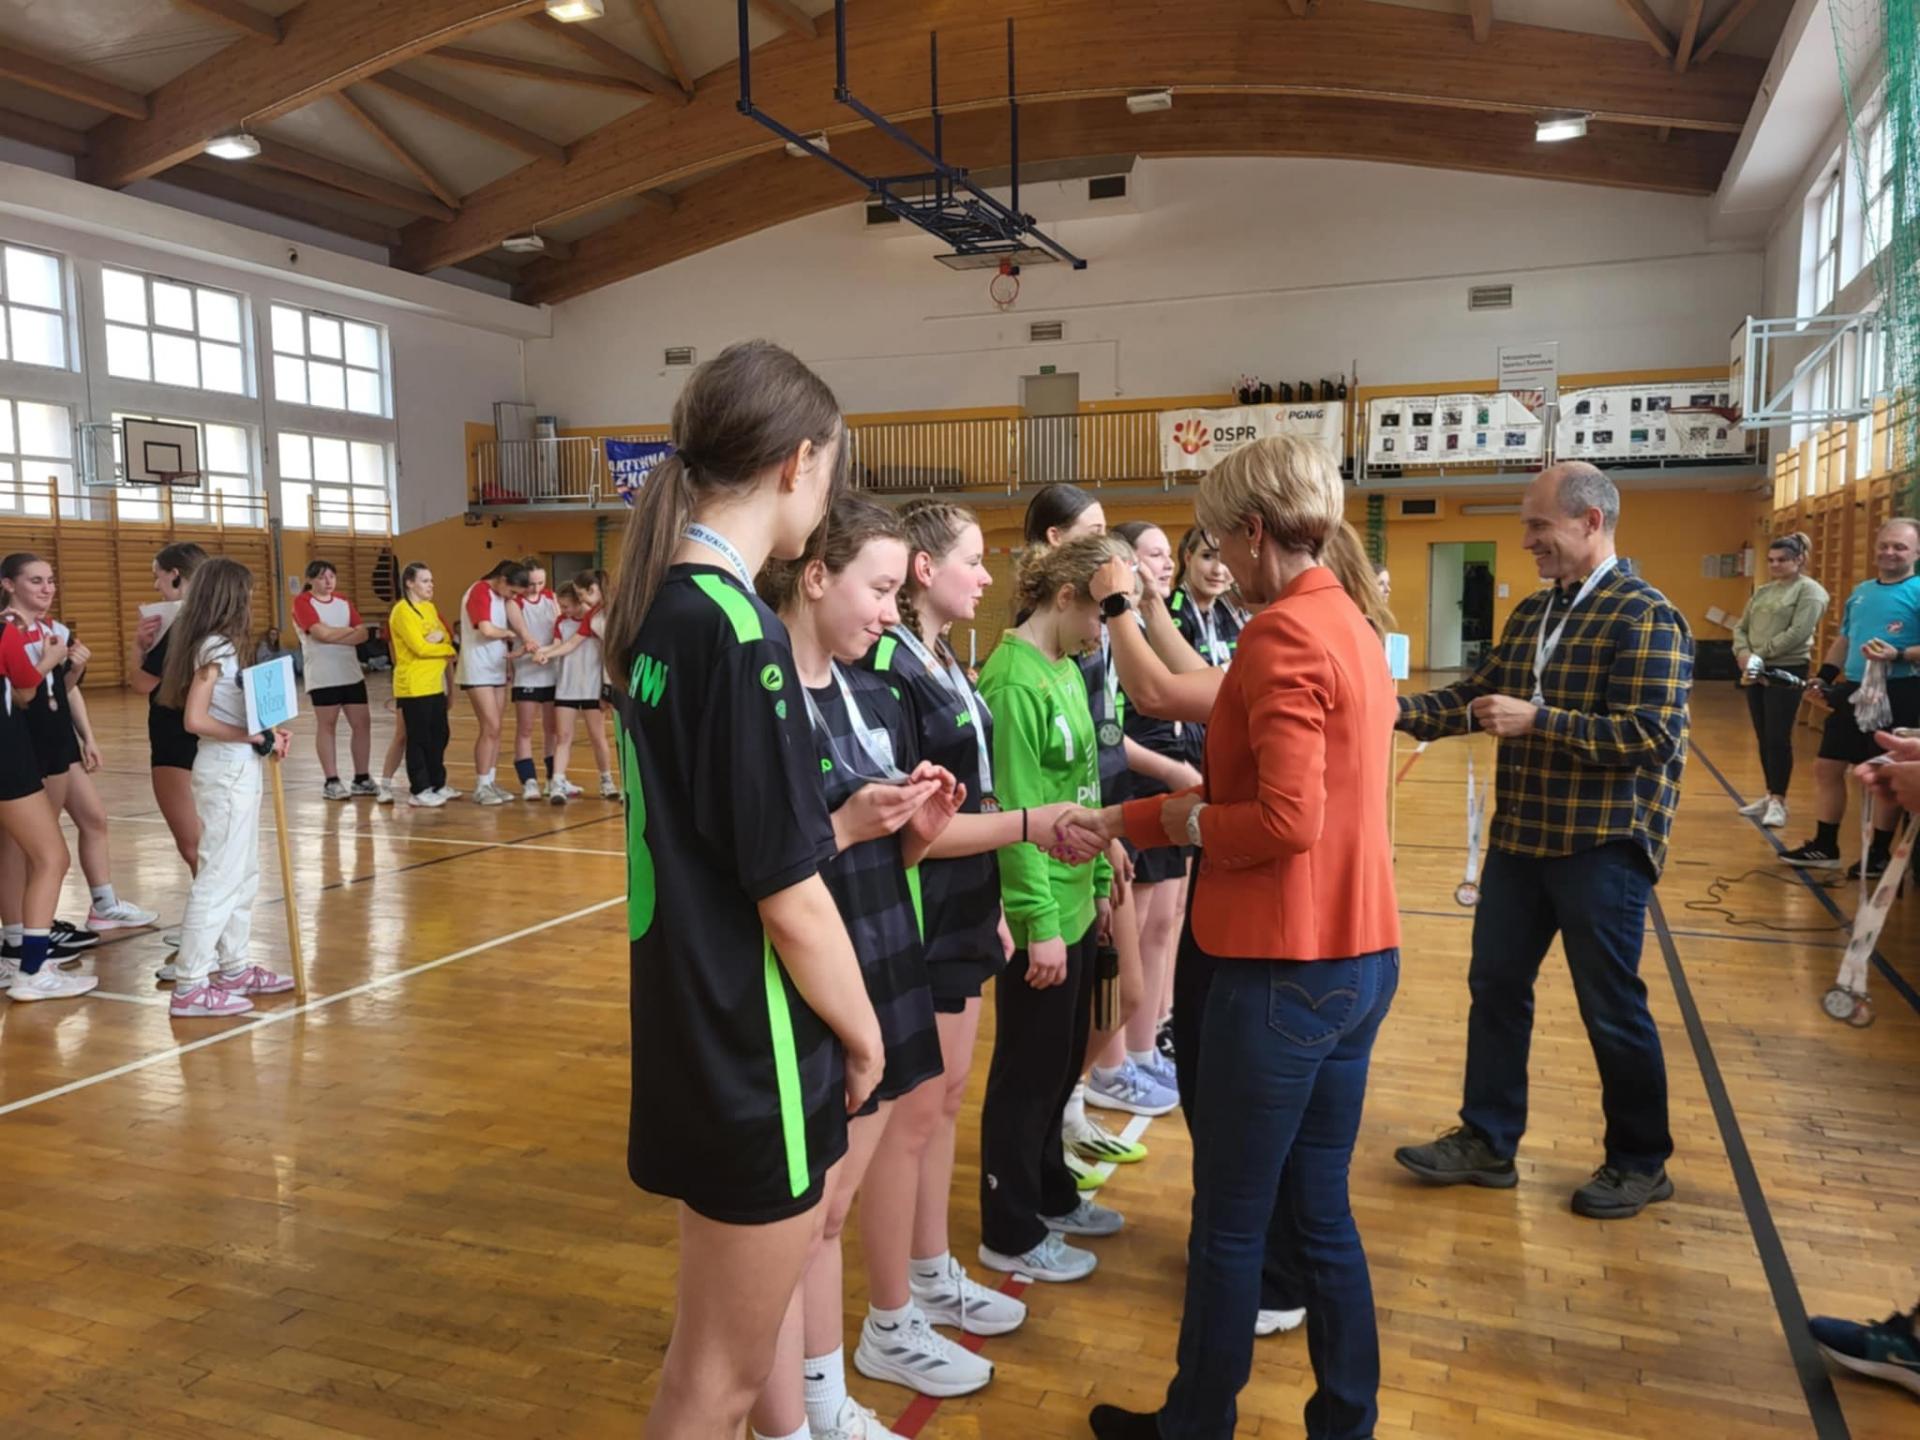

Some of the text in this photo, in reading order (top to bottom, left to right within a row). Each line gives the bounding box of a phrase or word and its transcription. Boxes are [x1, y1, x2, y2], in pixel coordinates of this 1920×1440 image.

[1289, 409, 1325, 420] PGNiG
[1213, 426, 1257, 442] OSPR
[1054, 714, 1075, 762] 1
